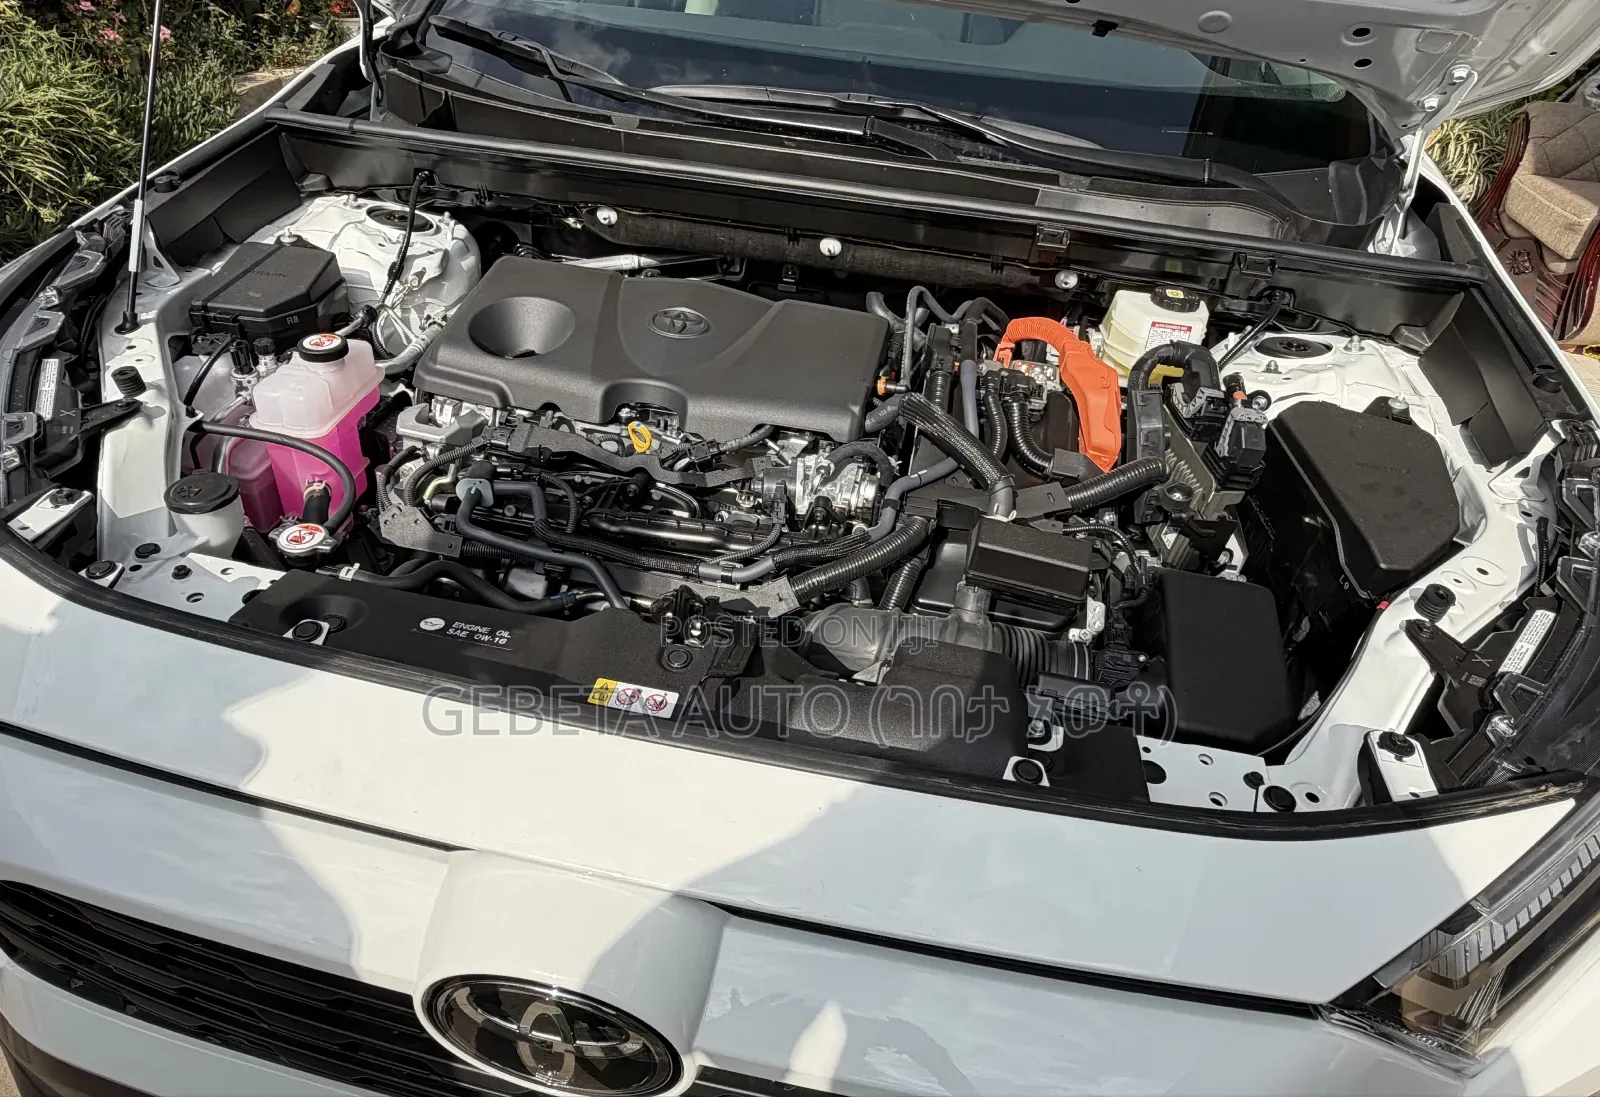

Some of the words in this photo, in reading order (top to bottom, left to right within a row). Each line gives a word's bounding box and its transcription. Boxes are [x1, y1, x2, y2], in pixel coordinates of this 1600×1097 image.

[446, 628, 469, 638] SAE
[452, 621, 491, 634] ENGINE
[496, 629, 512, 638] OIL
